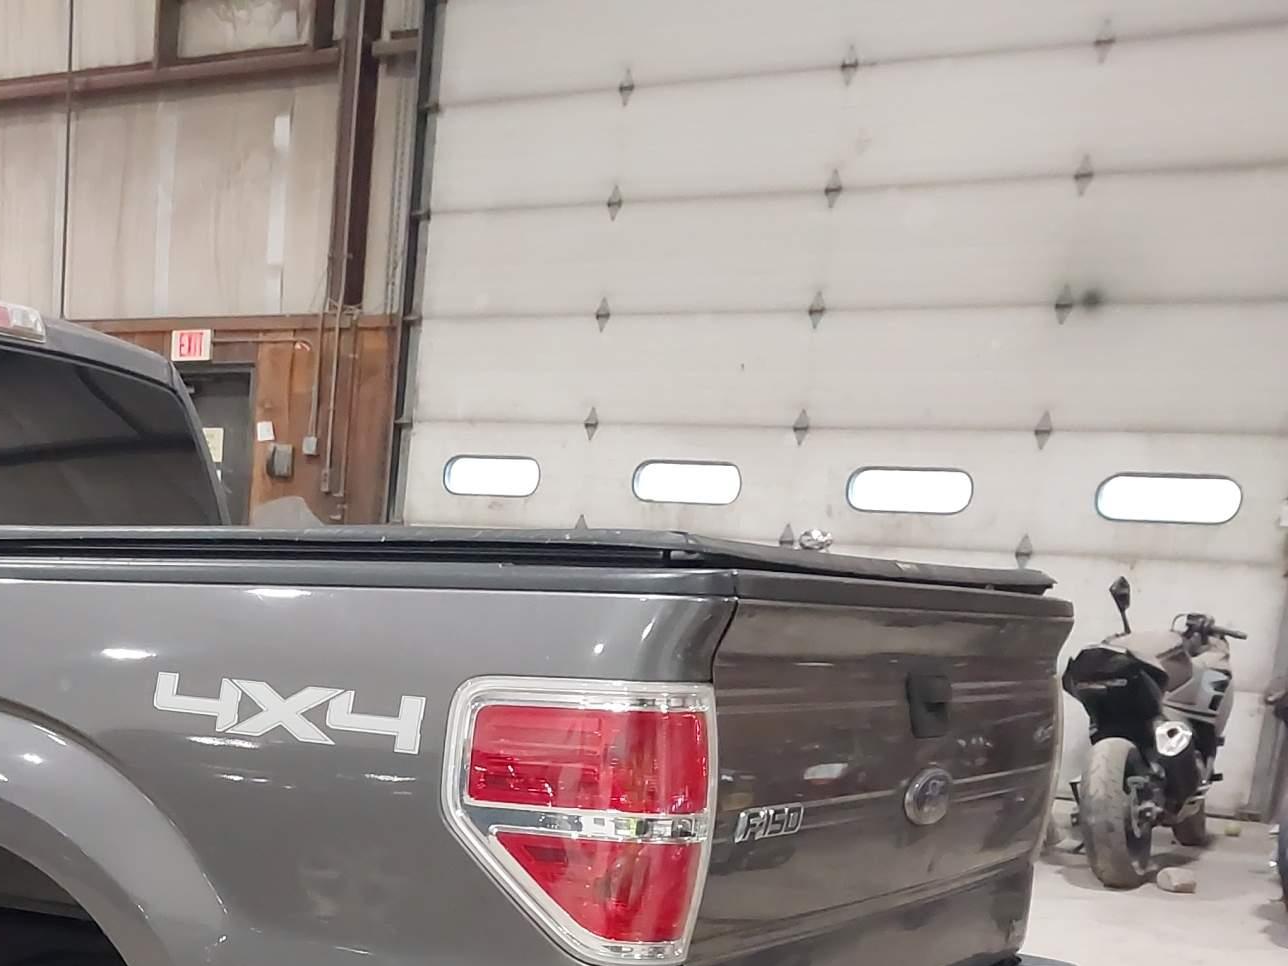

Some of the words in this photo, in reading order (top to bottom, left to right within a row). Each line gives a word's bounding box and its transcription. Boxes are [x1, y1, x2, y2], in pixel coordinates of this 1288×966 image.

[178, 331, 204, 358] EXIT
[153, 671, 427, 755] 4X4
[734, 802, 804, 843] F150
